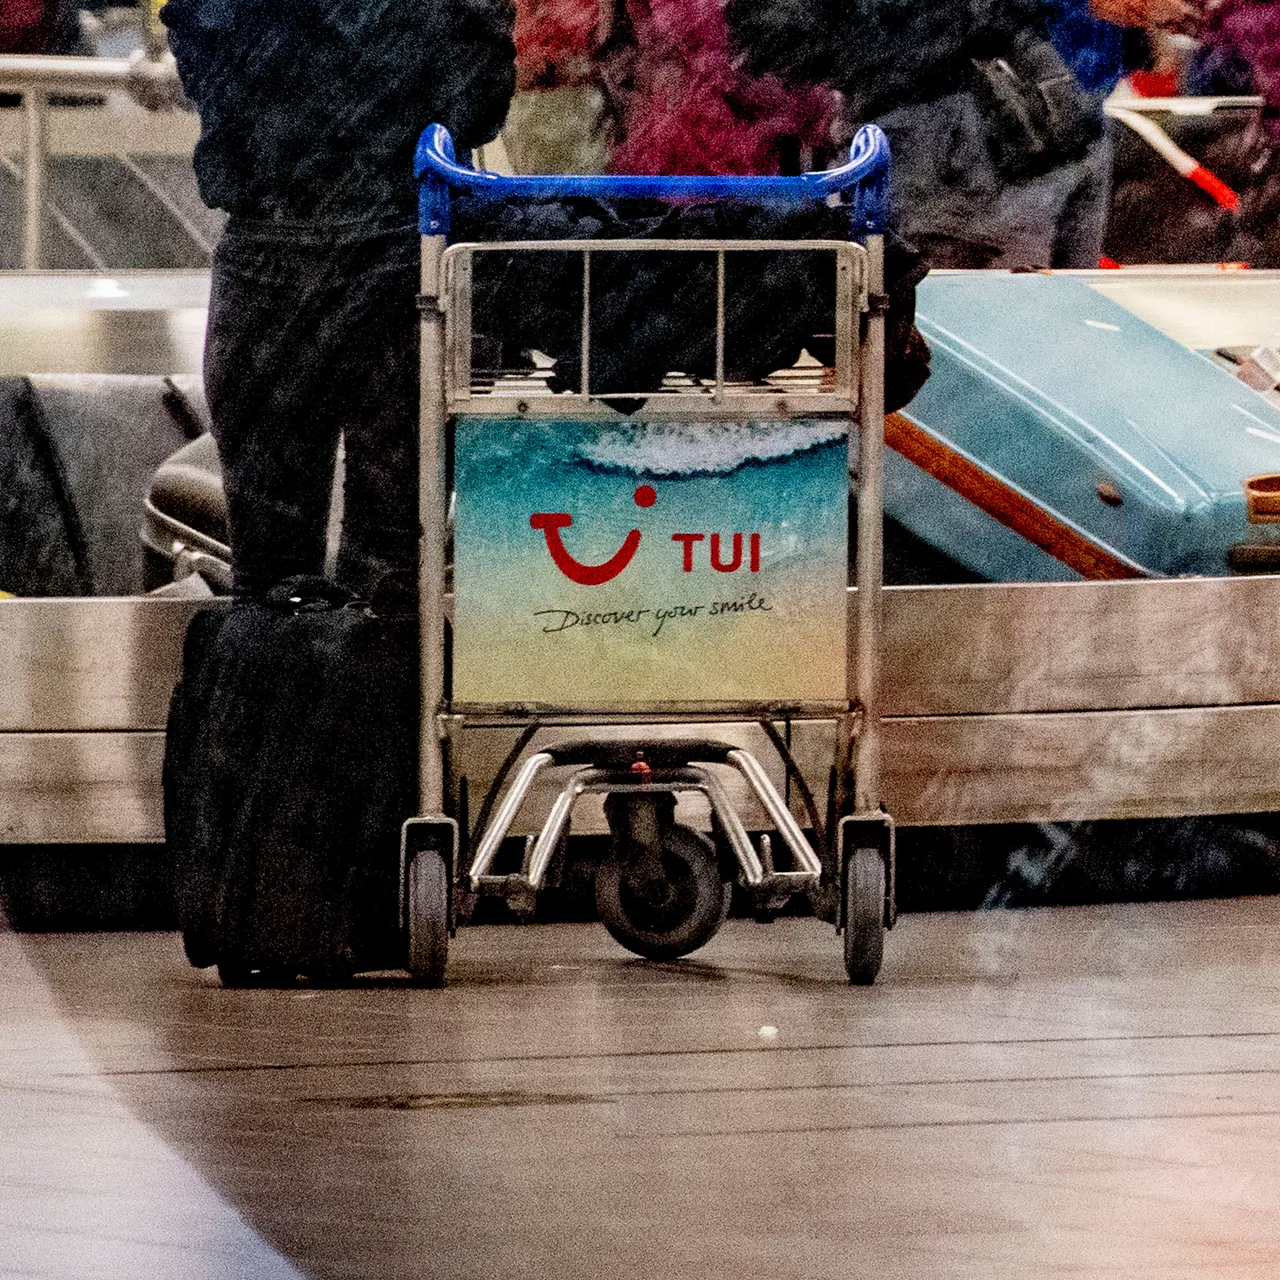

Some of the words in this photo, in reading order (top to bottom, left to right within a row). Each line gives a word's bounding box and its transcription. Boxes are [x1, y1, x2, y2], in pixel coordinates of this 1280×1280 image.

[671, 532, 761, 573] TUI
[532, 608, 651, 633] Discover
[653, 604, 703, 639] your
[708, 592, 775, 617] smile
